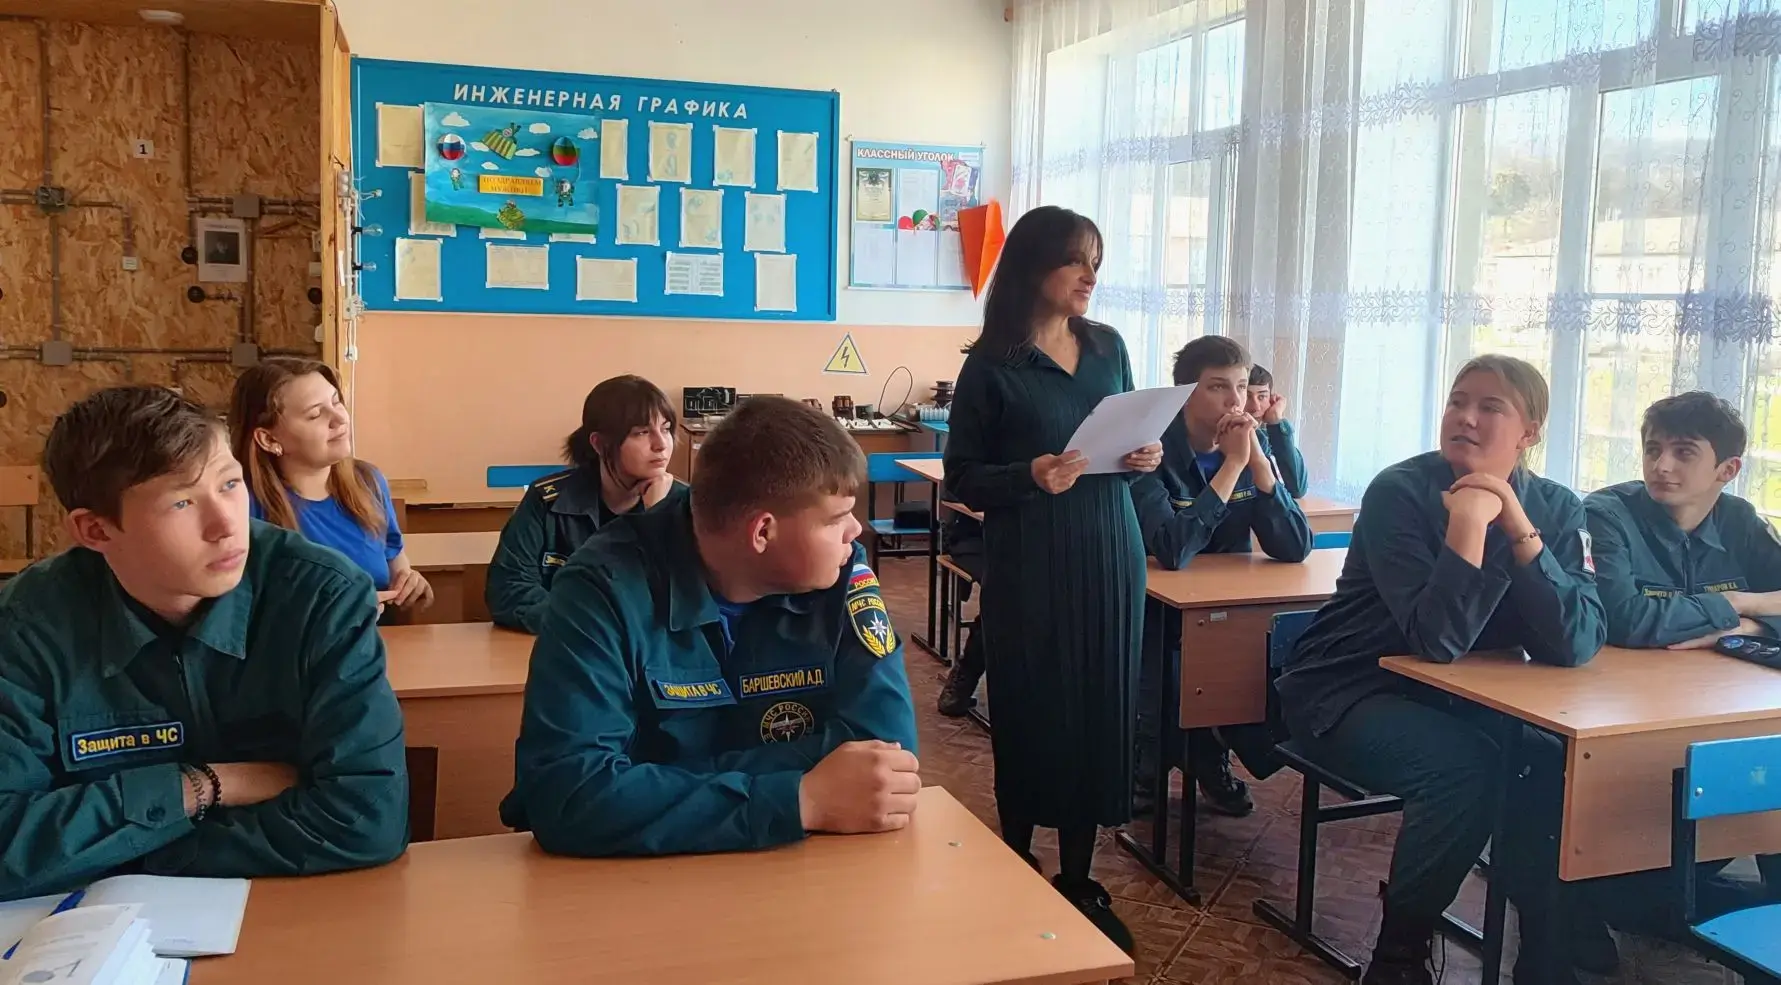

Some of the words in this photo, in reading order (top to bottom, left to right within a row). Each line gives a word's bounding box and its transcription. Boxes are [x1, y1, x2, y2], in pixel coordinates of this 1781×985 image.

[453, 83, 621, 112] ИНЖЕНЕРНАЯ
[637, 95, 748, 120] ГРАФИКА
[139, 143, 148, 155] 1
[856, 147, 915, 161] КЛАССНЫЙ
[916, 151, 954, 163] УГОЛОК
[705, 682, 722, 696] ЧС
[741, 670, 806, 694] БАРШЕВСКИЙ
[807, 668, 825, 686] А.Д.
[77, 735, 136, 755] Защита
[140, 733, 151, 745] в
[155, 726, 178, 744] ЧС
